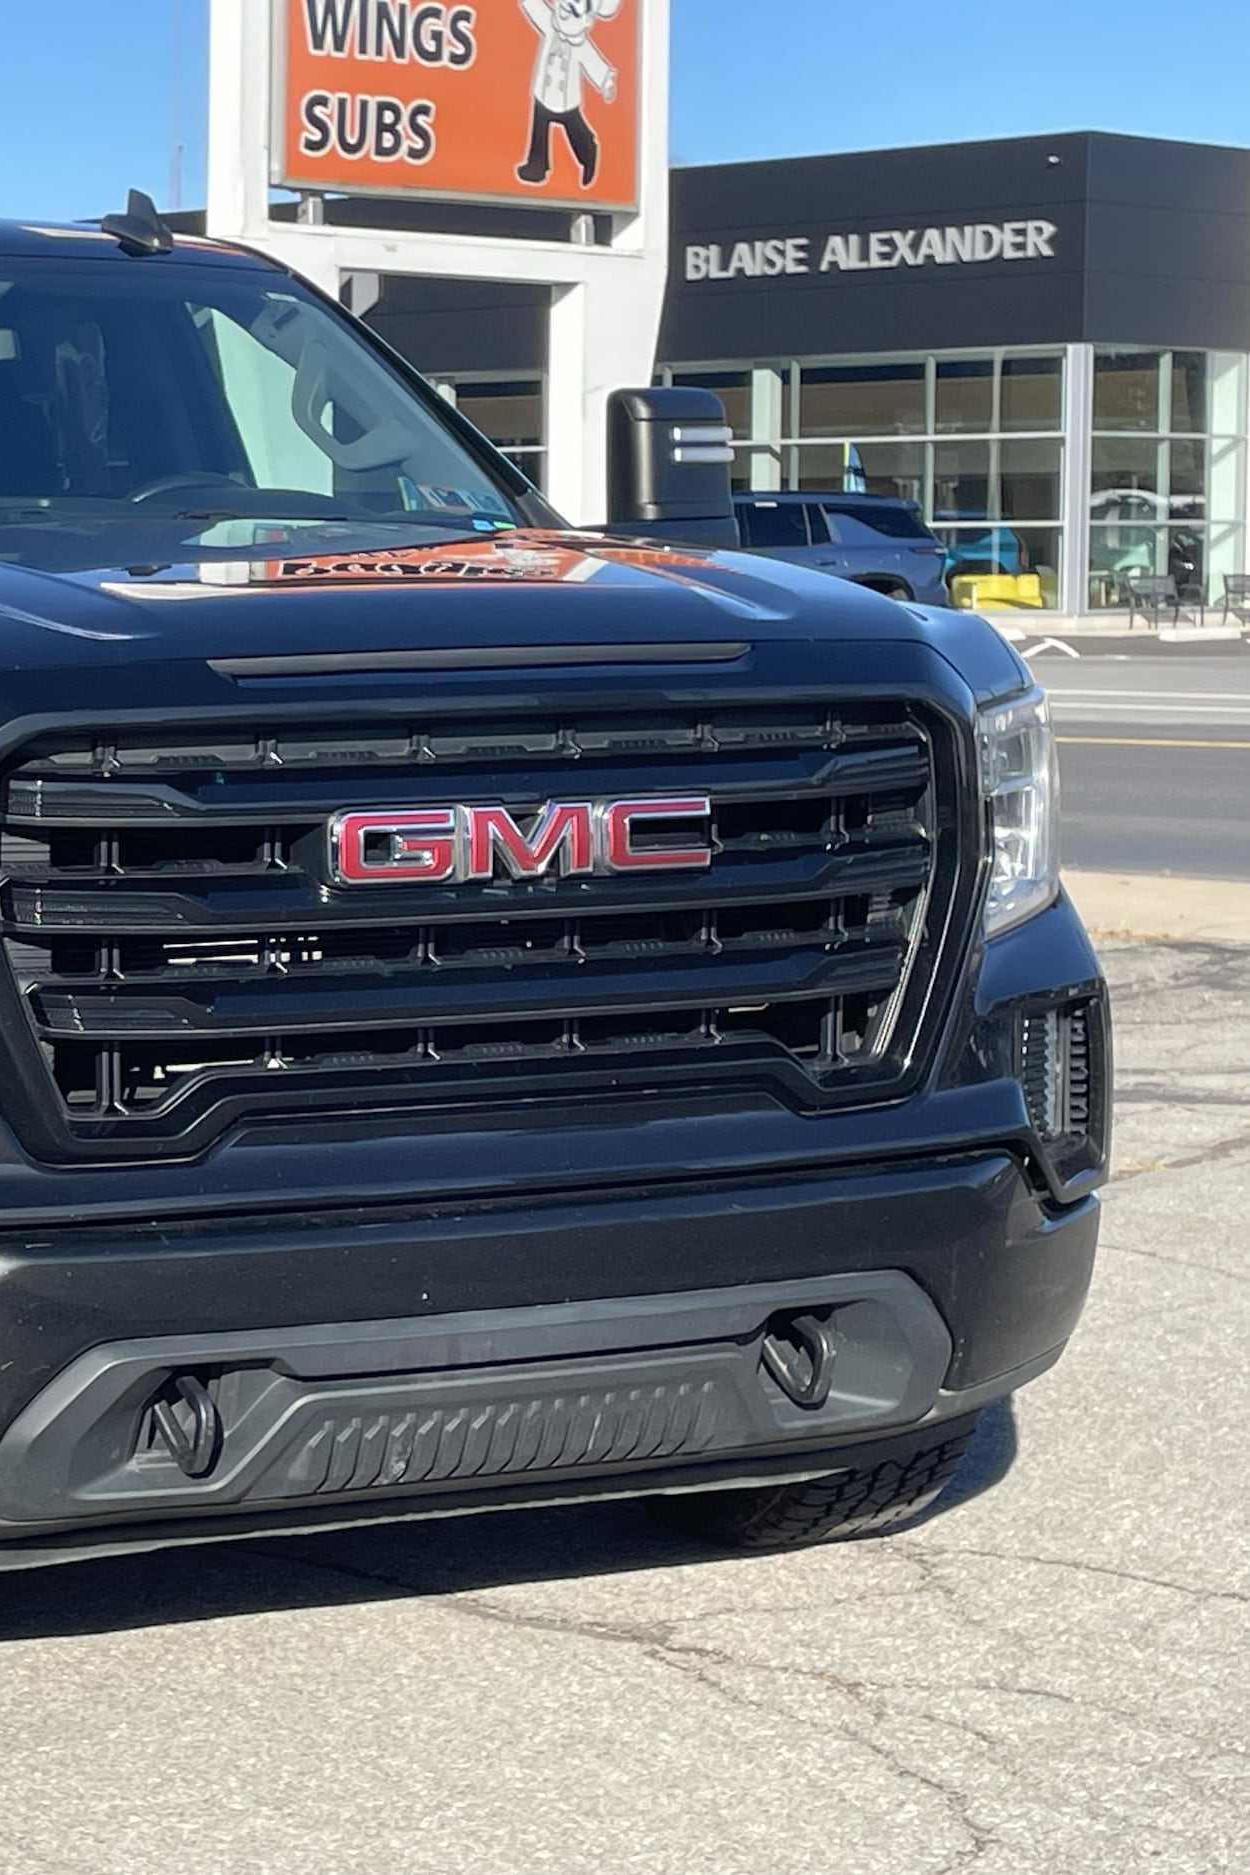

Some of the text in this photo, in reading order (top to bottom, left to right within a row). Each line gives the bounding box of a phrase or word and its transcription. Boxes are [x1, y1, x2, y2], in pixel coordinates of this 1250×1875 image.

[306, 0, 475, 66] WINGS
[303, 93, 433, 160] SUBS
[685, 219, 1058, 282] BLAISE ALEXANDER
[330, 796, 711, 885] GMC
